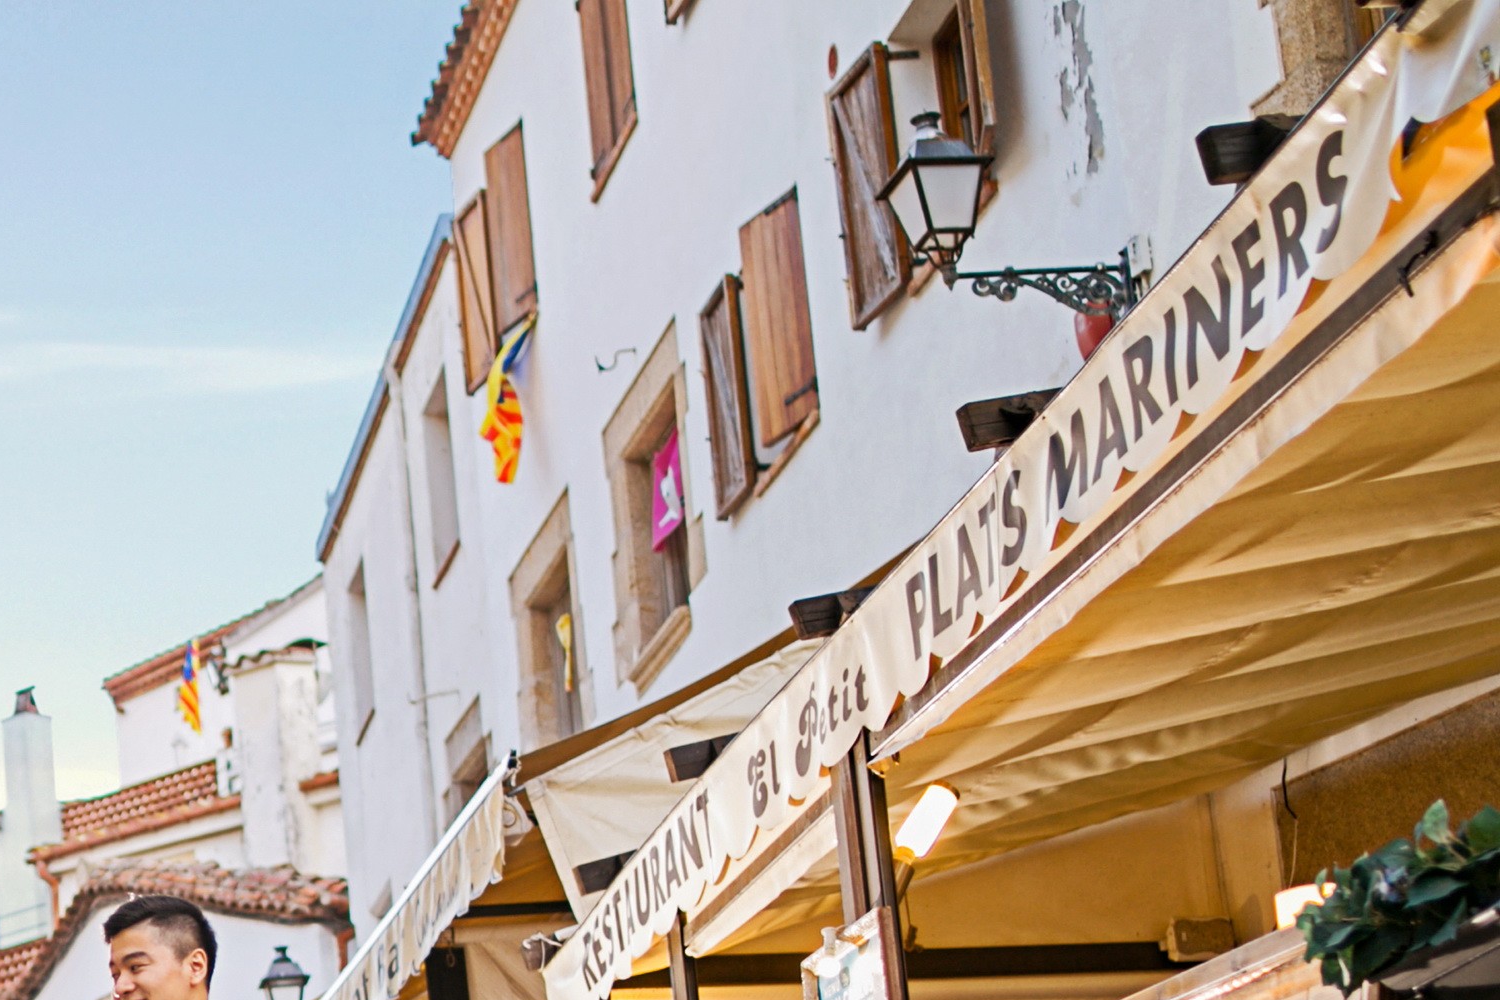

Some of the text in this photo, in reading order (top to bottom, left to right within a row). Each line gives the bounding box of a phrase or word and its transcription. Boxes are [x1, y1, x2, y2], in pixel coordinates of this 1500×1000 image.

[581, 130, 1349, 992] RESTAURANT El Petit PLATS MARINERS
